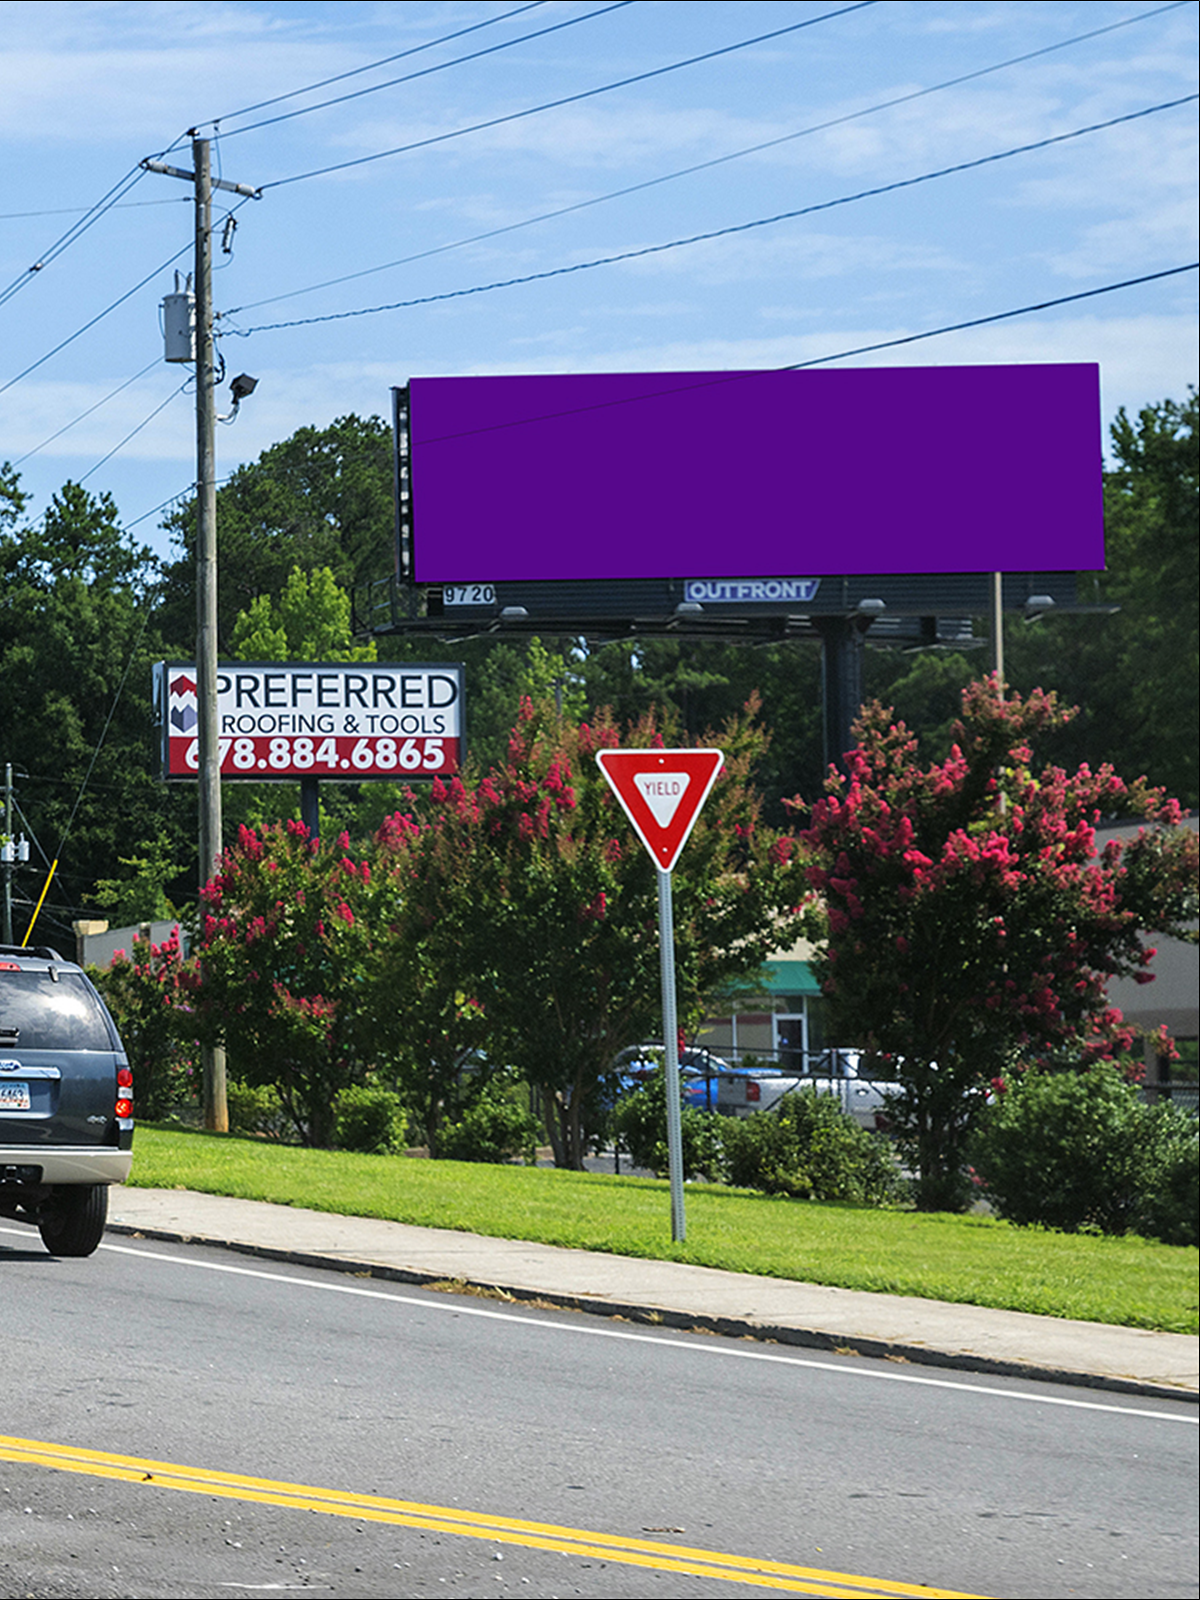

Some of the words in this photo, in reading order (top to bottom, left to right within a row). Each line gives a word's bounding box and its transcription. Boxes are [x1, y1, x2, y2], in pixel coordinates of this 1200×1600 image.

[445, 585, 494, 602] 9720
[689, 581, 812, 599] OUTFRONT
[217, 673, 459, 708] PREFERRED
[222, 714, 335, 734] ROOFING
[343, 714, 360, 734] &
[366, 714, 446, 734] TOOLS
[184, 737, 445, 770] 678.884.6865
[643, 781, 681, 796] YIELD
